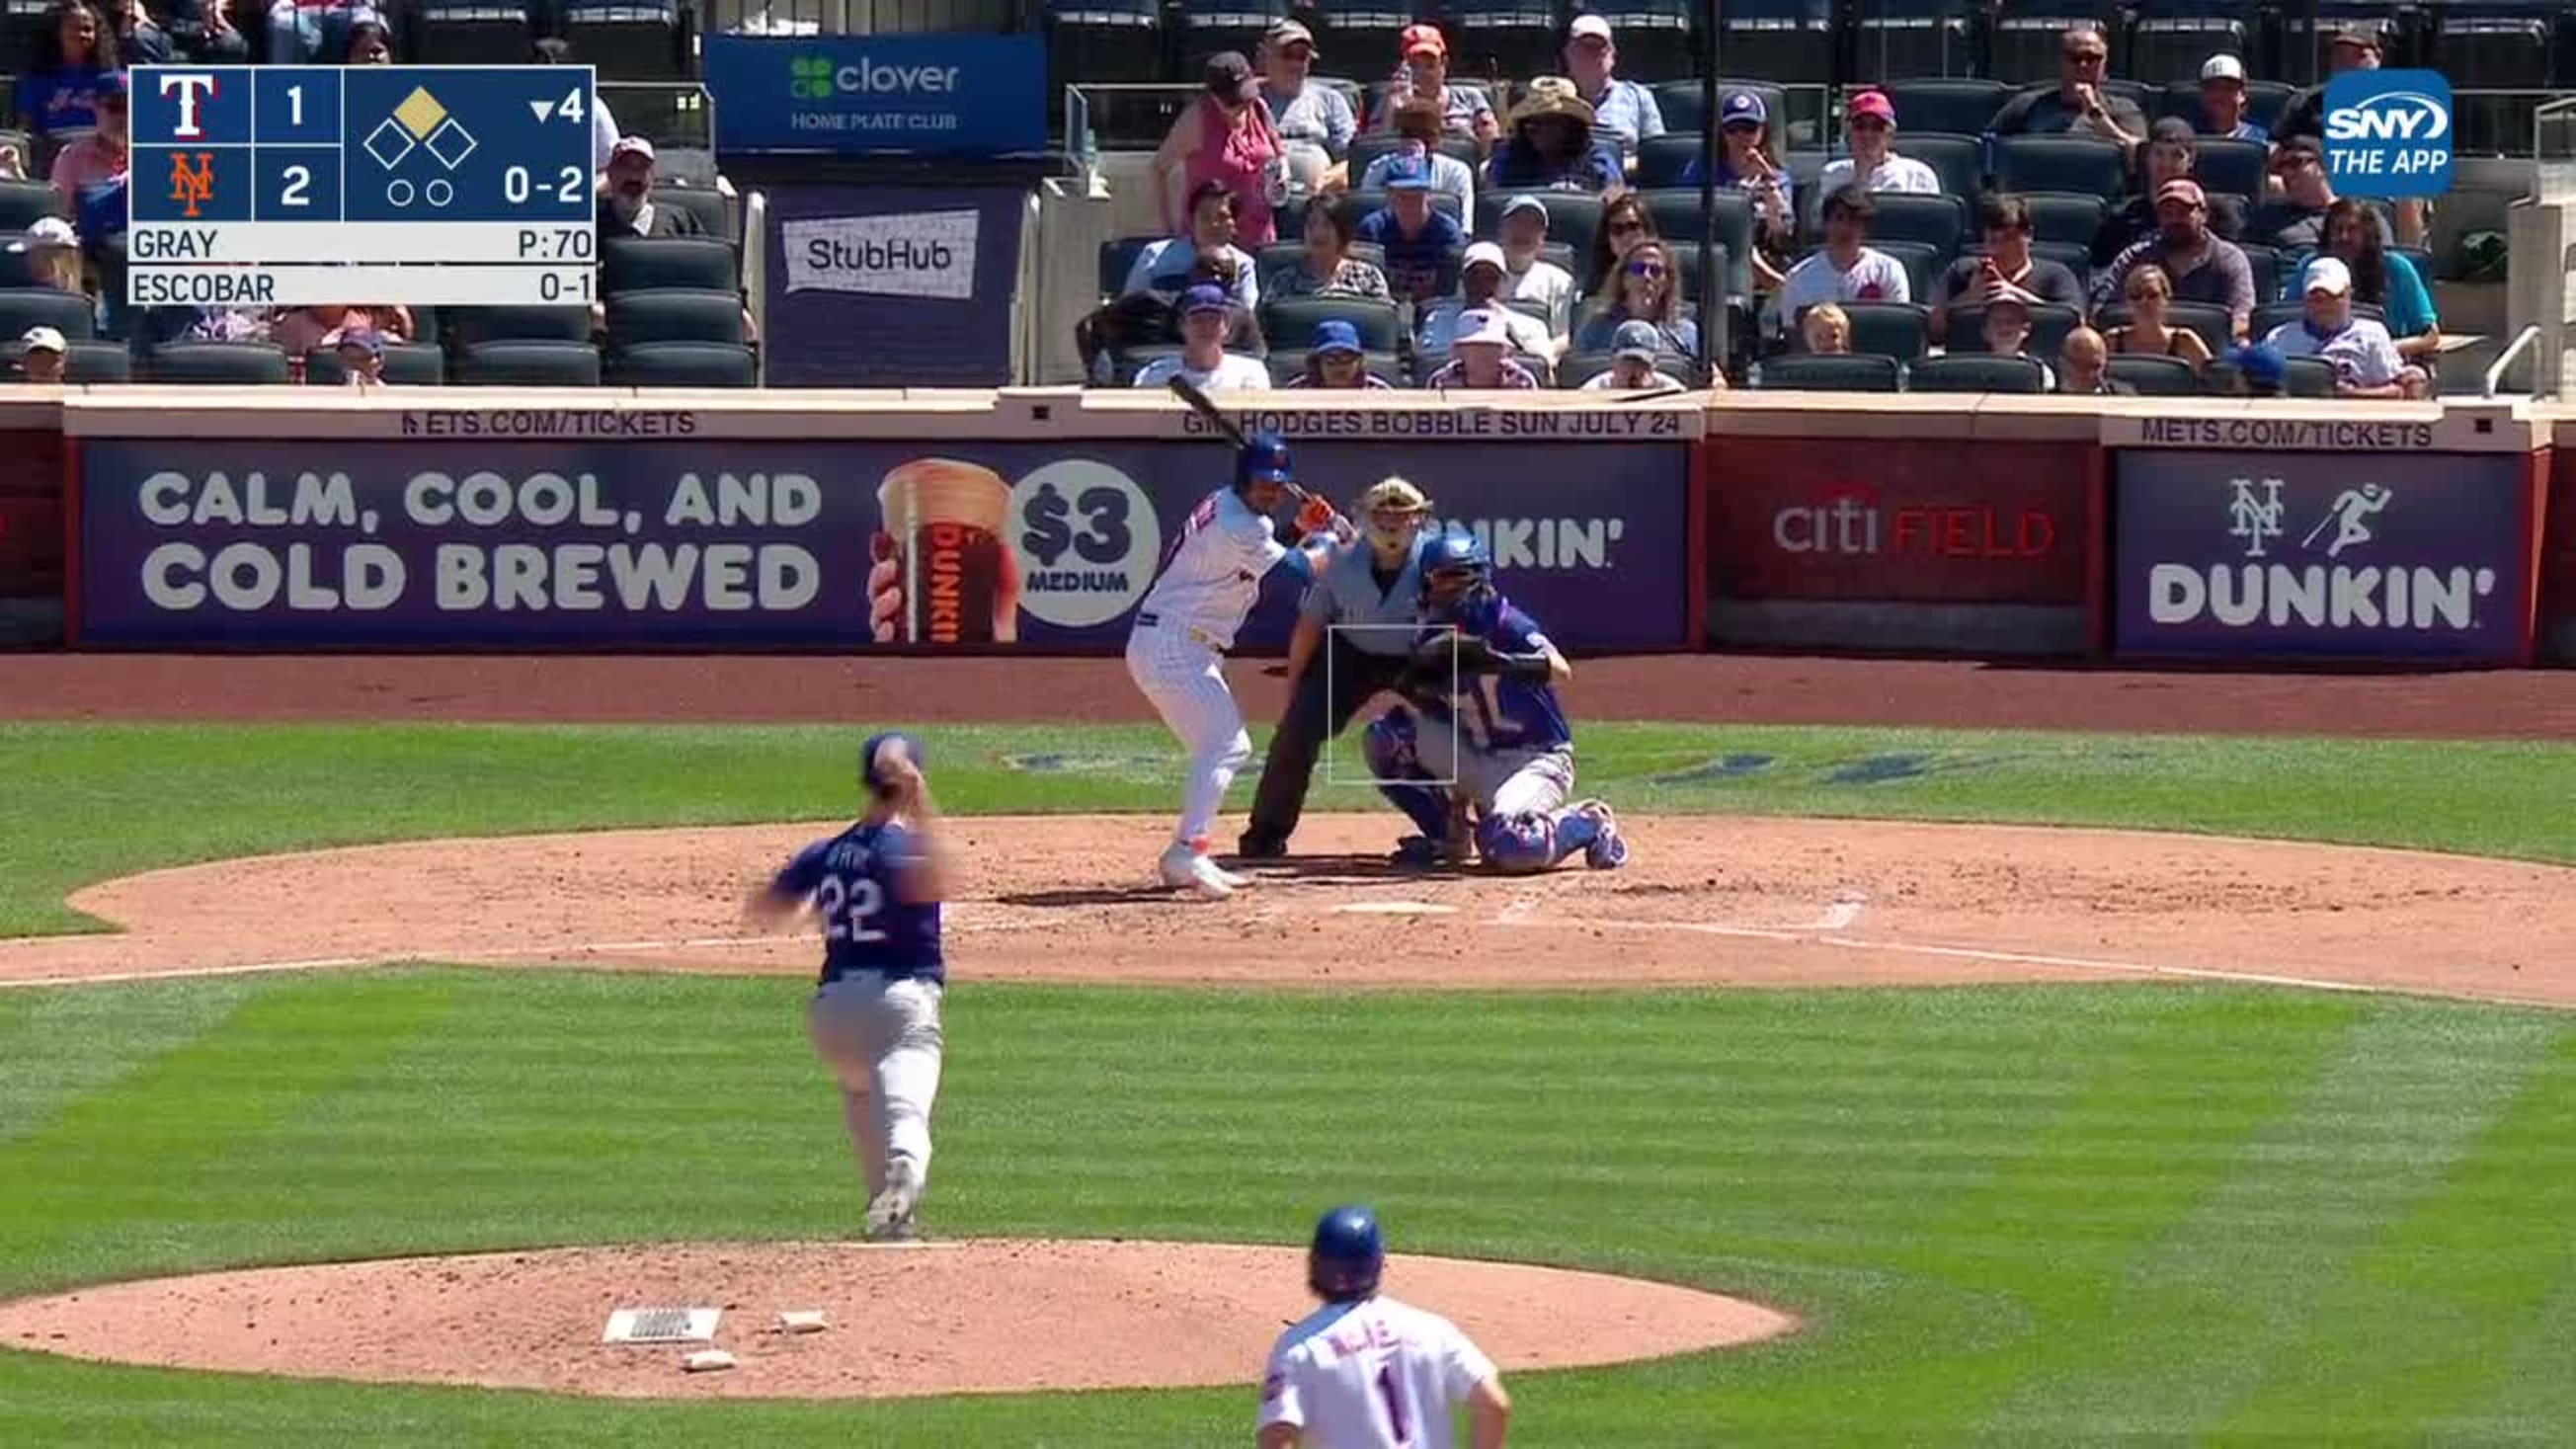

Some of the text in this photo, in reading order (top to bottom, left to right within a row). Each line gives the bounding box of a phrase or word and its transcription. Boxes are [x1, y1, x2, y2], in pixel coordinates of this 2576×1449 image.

[837, 56, 959, 92] clover
[791, 113, 957, 130] HOME PLATE CLUB
[806, 238, 952, 270] StubHub
[1240, 411, 1362, 435] HODGES
[1371, 410, 1490, 435] BOBBLE
[1499, 411, 1560, 436] SUN
[1568, 411, 1640, 436] JULY
[1650, 411, 1680, 435] 24
[2141, 418, 2433, 446] METS.COM/TICKETS
[139, 470, 822, 534] CALM, COOL, AND
[1021, 482, 1133, 567] $3
[1891, 506, 2056, 557] FIELD
[141, 541, 821, 611] COLD BREWED
[1026, 572, 1129, 593] MEDIUM
[2148, 562, 2497, 629] DUNKIN'
[820, 875, 888, 942] 22
[1375, 1363, 1411, 1445] 1
